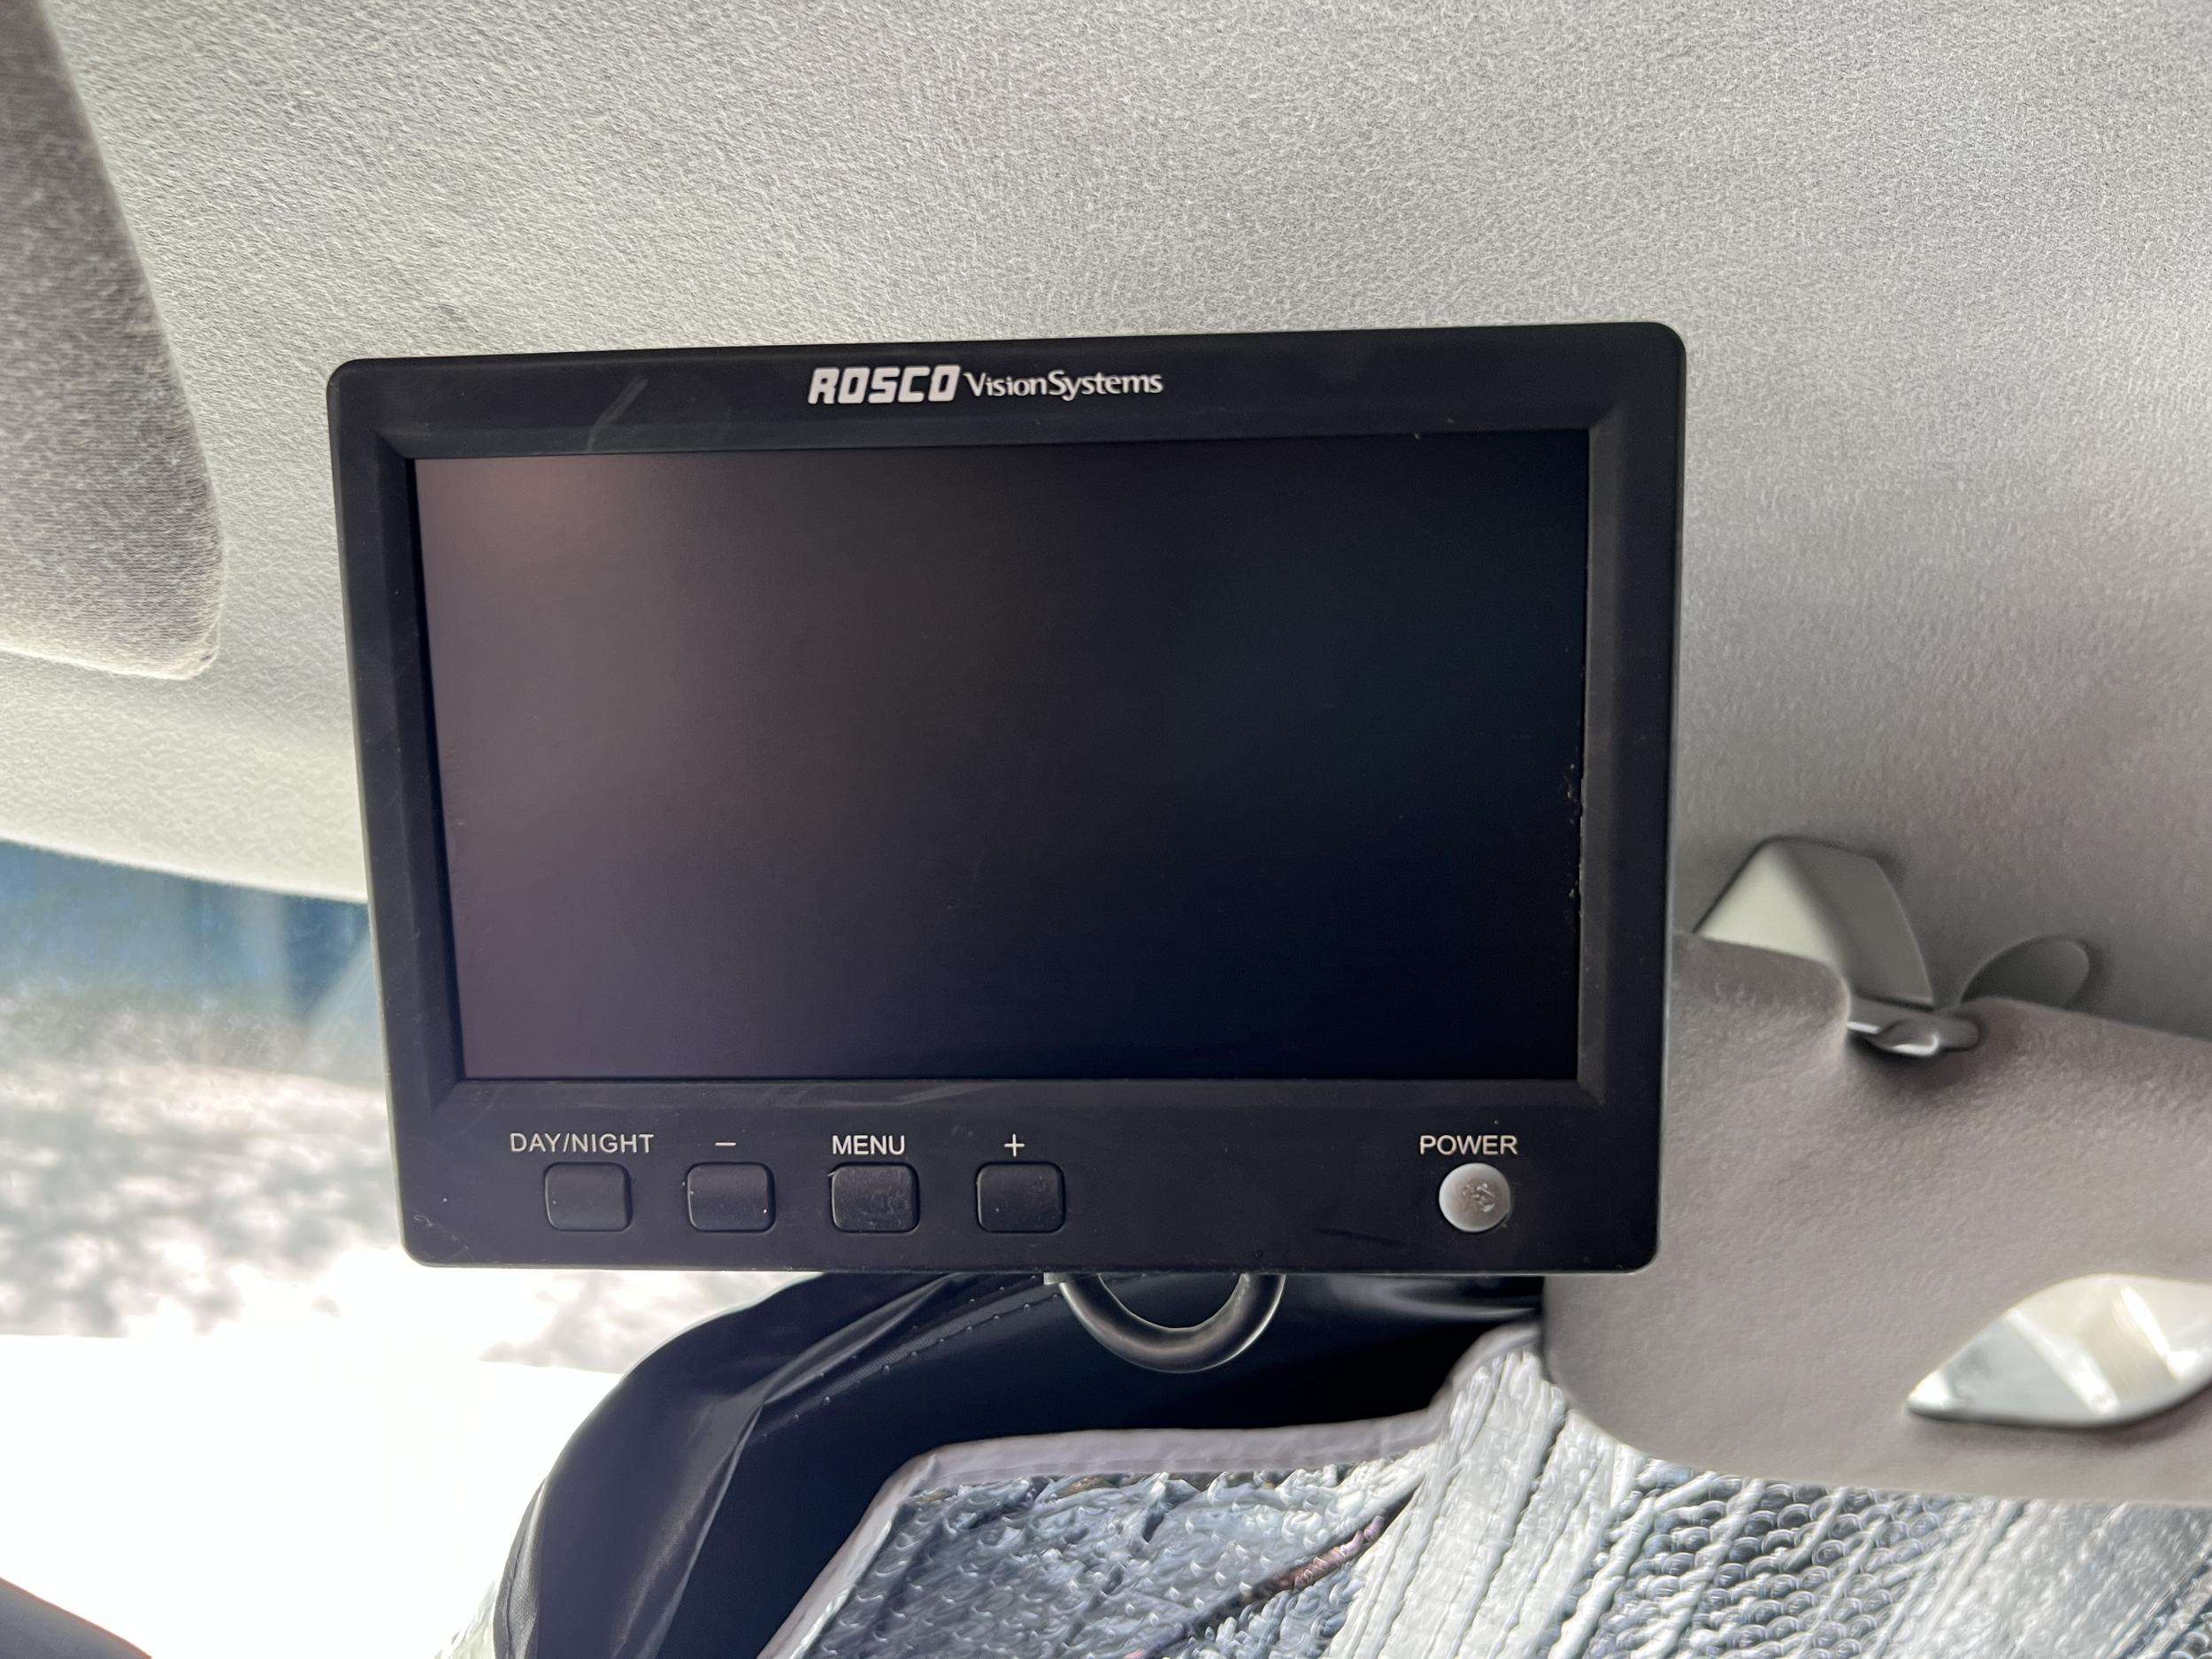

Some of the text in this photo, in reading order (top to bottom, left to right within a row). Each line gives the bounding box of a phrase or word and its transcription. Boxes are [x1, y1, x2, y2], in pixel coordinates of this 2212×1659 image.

[807, 364, 961, 405] ROSCO
[509, 1133, 655, 1155] DAY/NIGHT
[831, 1134, 906, 1156] MENU
[1418, 1134, 1519, 1156] POWER
